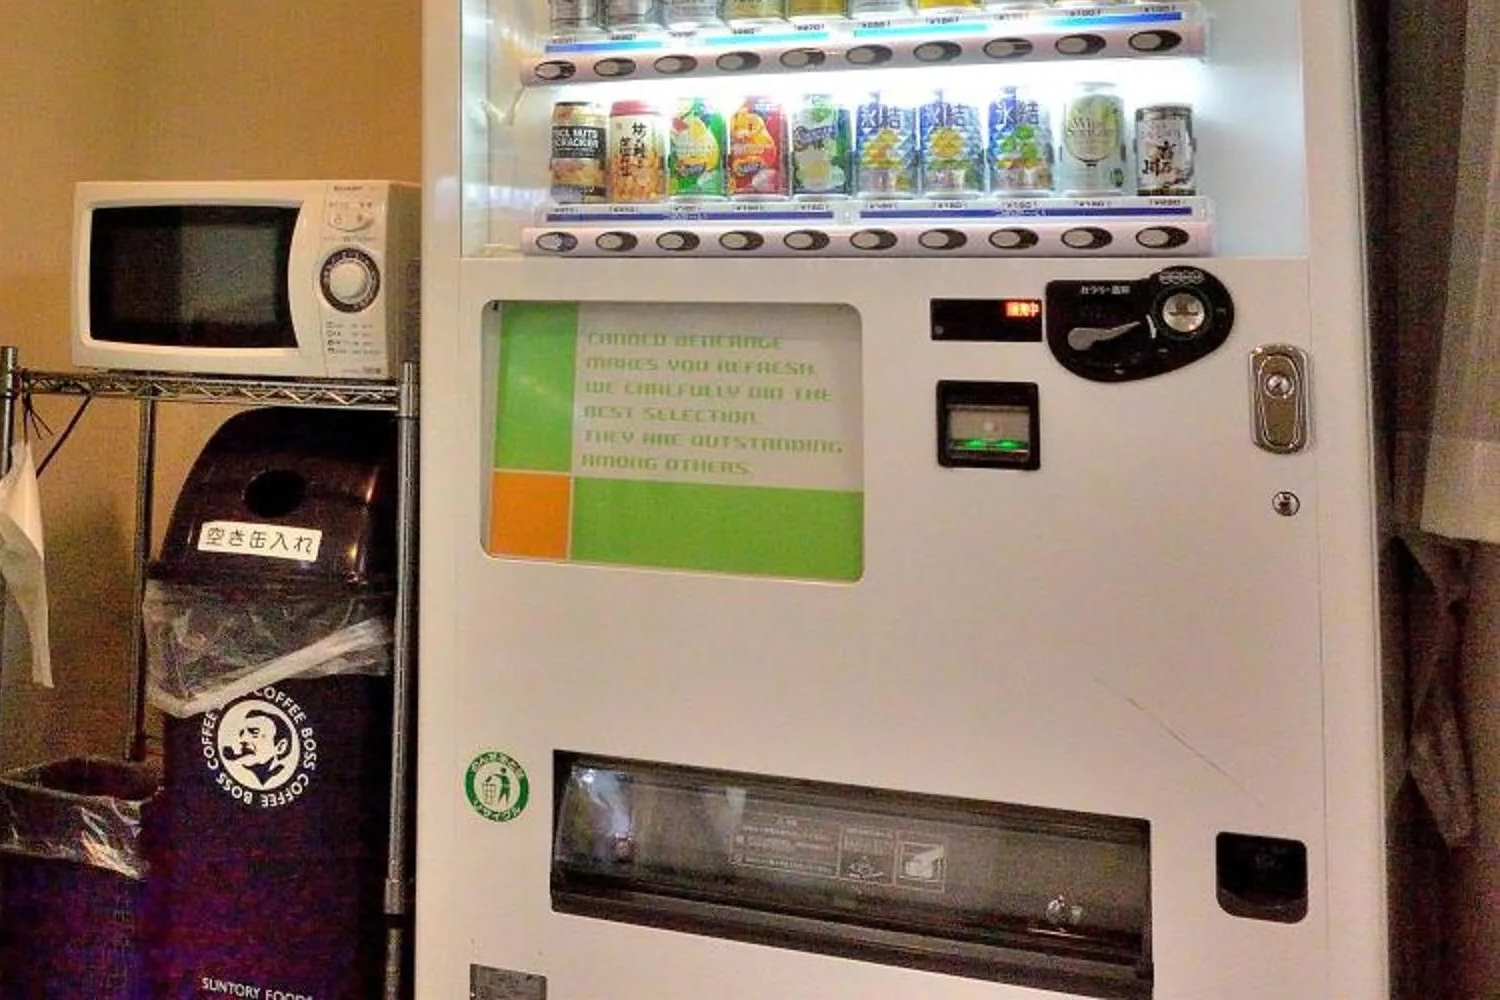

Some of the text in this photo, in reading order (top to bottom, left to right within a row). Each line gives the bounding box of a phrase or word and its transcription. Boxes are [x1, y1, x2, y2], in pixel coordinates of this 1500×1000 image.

[206, 526, 315, 556] 空き缶入れ
[301, 727, 317, 771] BOSS
[216, 772, 253, 805] BOSS
[260, 773, 309, 808] COFFEE
[200, 976, 261, 1000] SUNTORY
